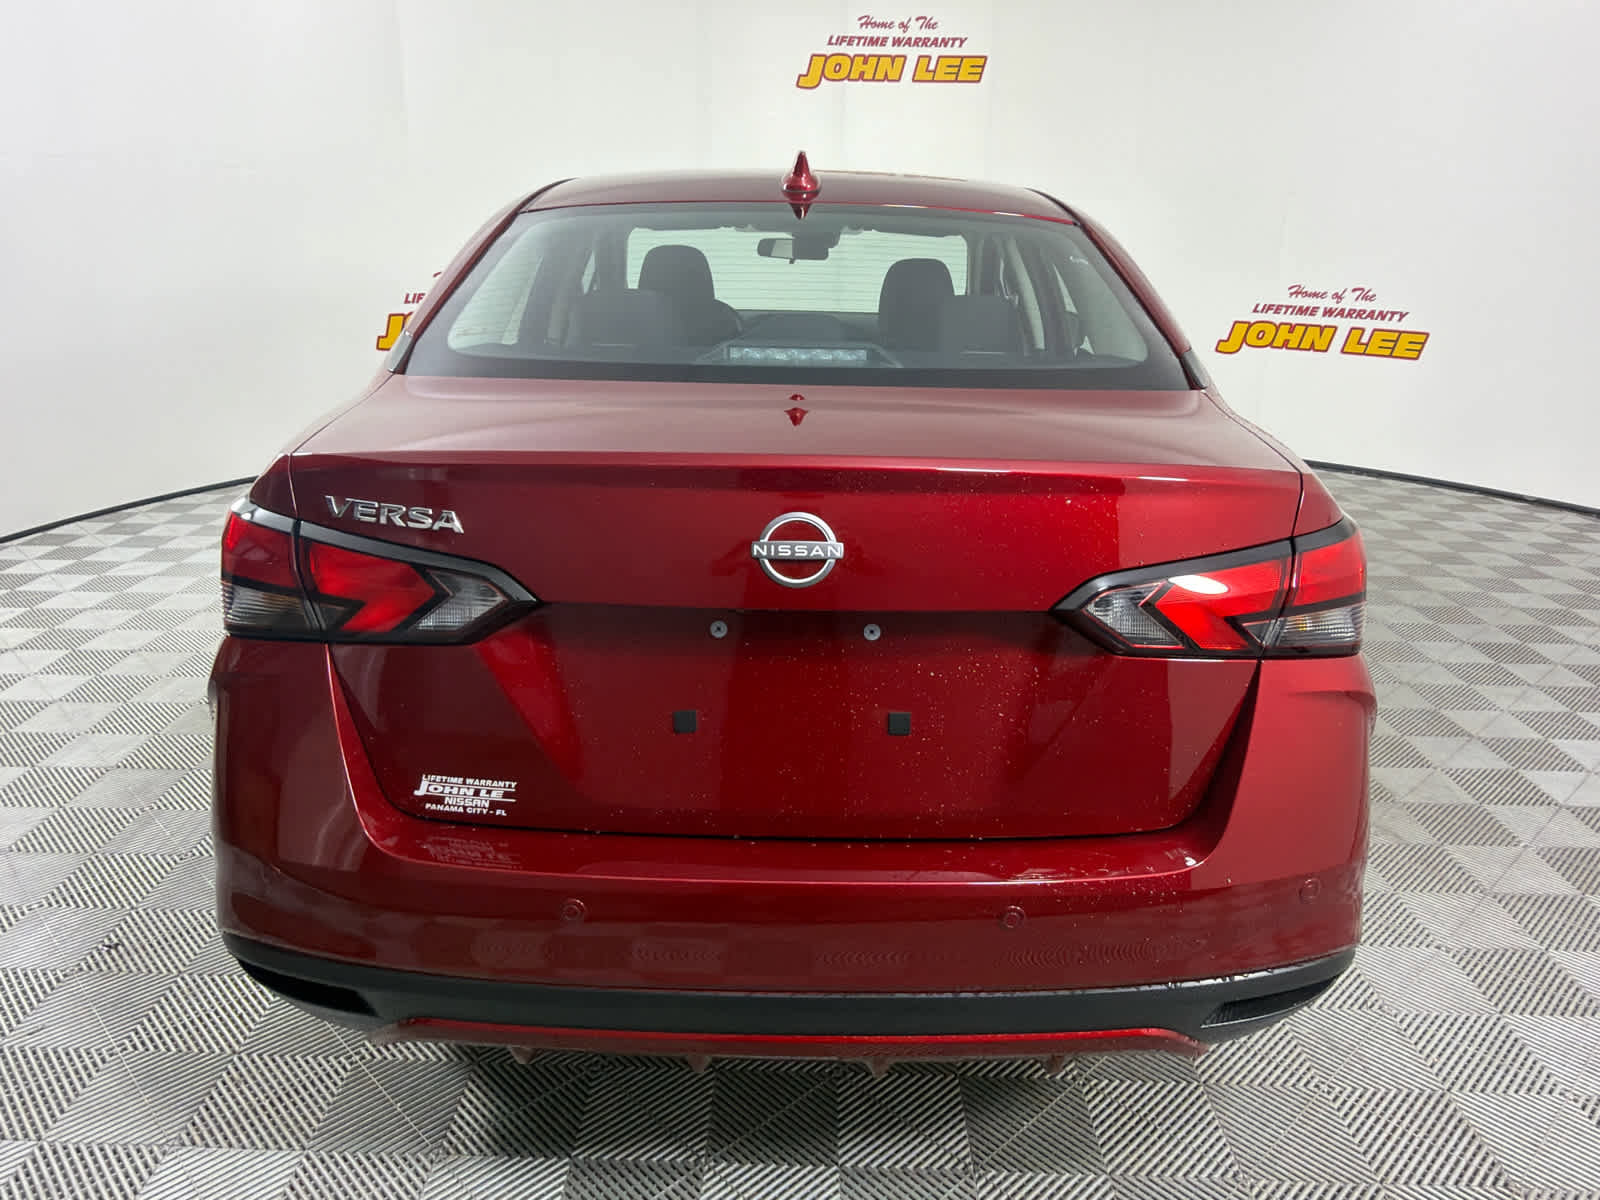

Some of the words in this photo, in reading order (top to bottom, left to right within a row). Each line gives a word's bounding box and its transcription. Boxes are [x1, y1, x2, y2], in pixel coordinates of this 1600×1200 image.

[857, 15, 895, 29] Home
[898, 17, 912, 33] of
[915, 16, 938, 30] The
[827, 35, 889, 47] LIFETIME
[891, 36, 968, 48] WARRANTY
[796, 53, 907, 89] JOHN
[912, 55, 988, 83] LEE
[1288, 284, 1328, 300] Home
[1331, 288, 1347, 304] of
[1352, 287, 1377, 302] The
[1251, 303, 1320, 317] LIFETIME
[1322, 306, 1410, 322] WARRANTY
[1215, 320, 1337, 354] JOHN
[1341, 327, 1430, 360] LEE
[325, 495, 464, 534] VERSA
[753, 544, 841, 557] NISSAN
[413, 779, 475, 796] JOHN
[422, 774, 464, 784] LIFETIME
[465, 777, 517, 788] WARRANTY
[425, 803, 464, 813] PANAMA
[466, 807, 488, 815] CITY
[444, 796, 490, 808] NISSAN
